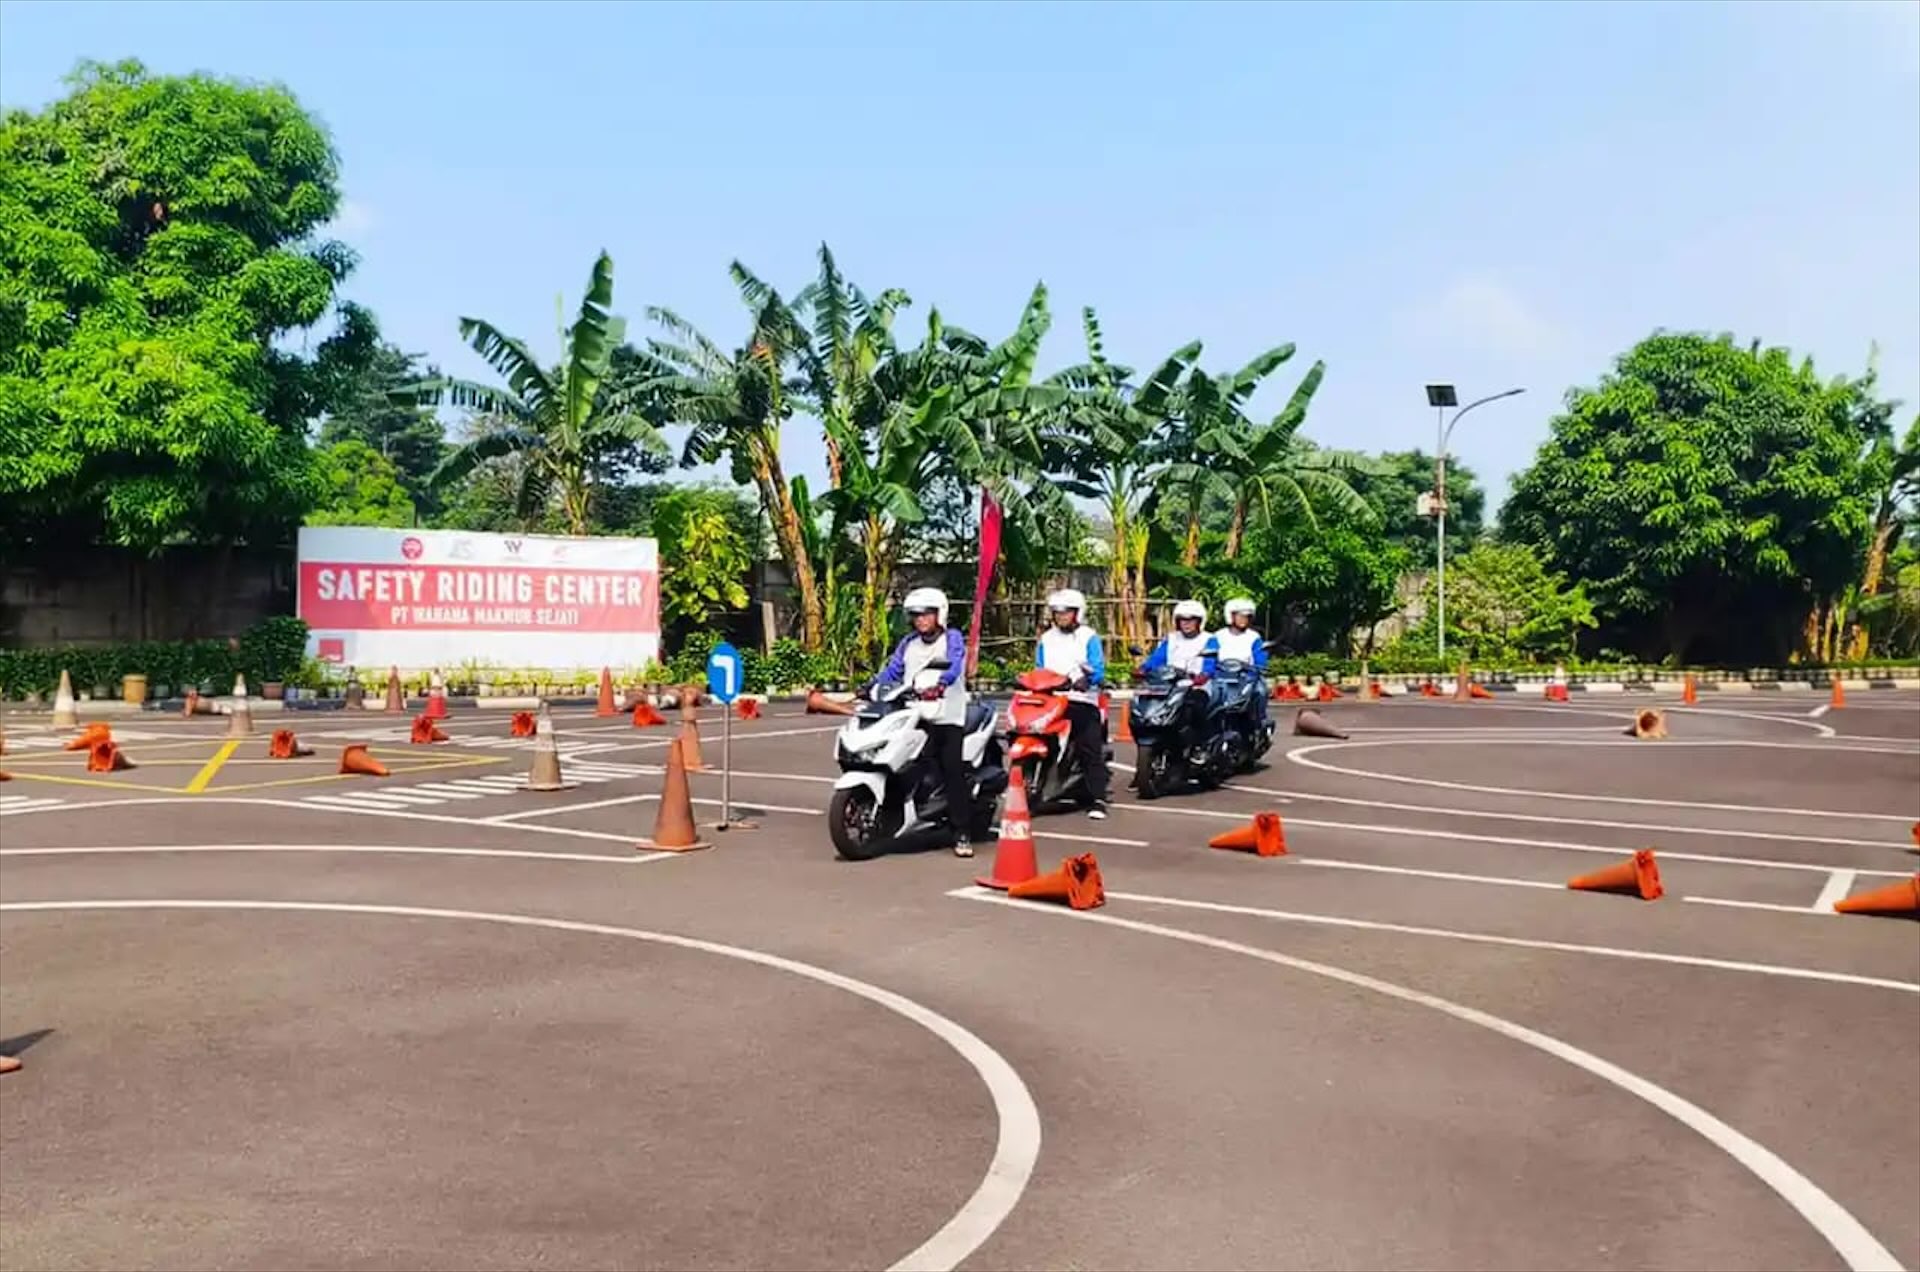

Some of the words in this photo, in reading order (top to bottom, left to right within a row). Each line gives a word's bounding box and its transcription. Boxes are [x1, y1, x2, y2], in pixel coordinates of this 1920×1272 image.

[317, 569, 425, 602] SAFETY
[437, 571, 533, 604] RIDING
[545, 574, 643, 607] CENTER
[391, 605, 409, 625] PT
